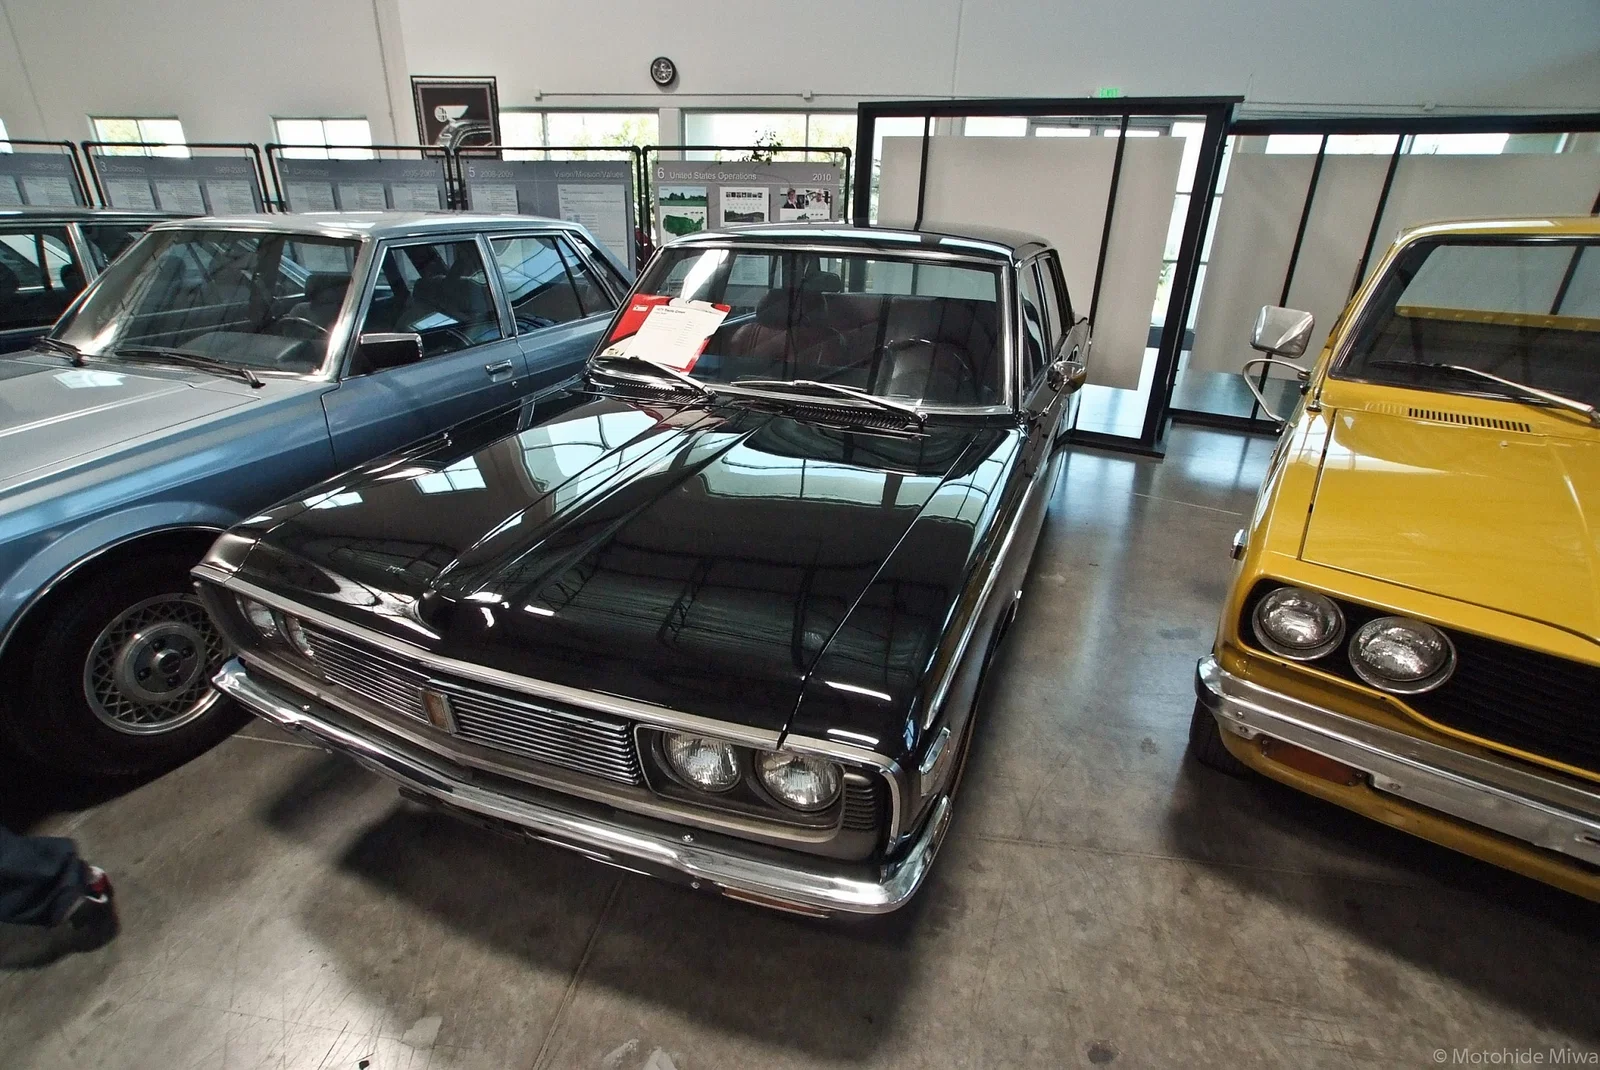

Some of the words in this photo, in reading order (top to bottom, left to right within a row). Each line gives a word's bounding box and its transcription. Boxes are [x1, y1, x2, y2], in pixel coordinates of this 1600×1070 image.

[99, 161, 108, 173] 3
[282, 163, 290, 175] 4
[468, 166, 476, 178] 5
[657, 167, 665, 179] 6
[669, 171, 693, 180] United
[694, 172, 716, 180] States
[717, 172, 757, 182] Operations
[812, 173, 832, 181] 2010
